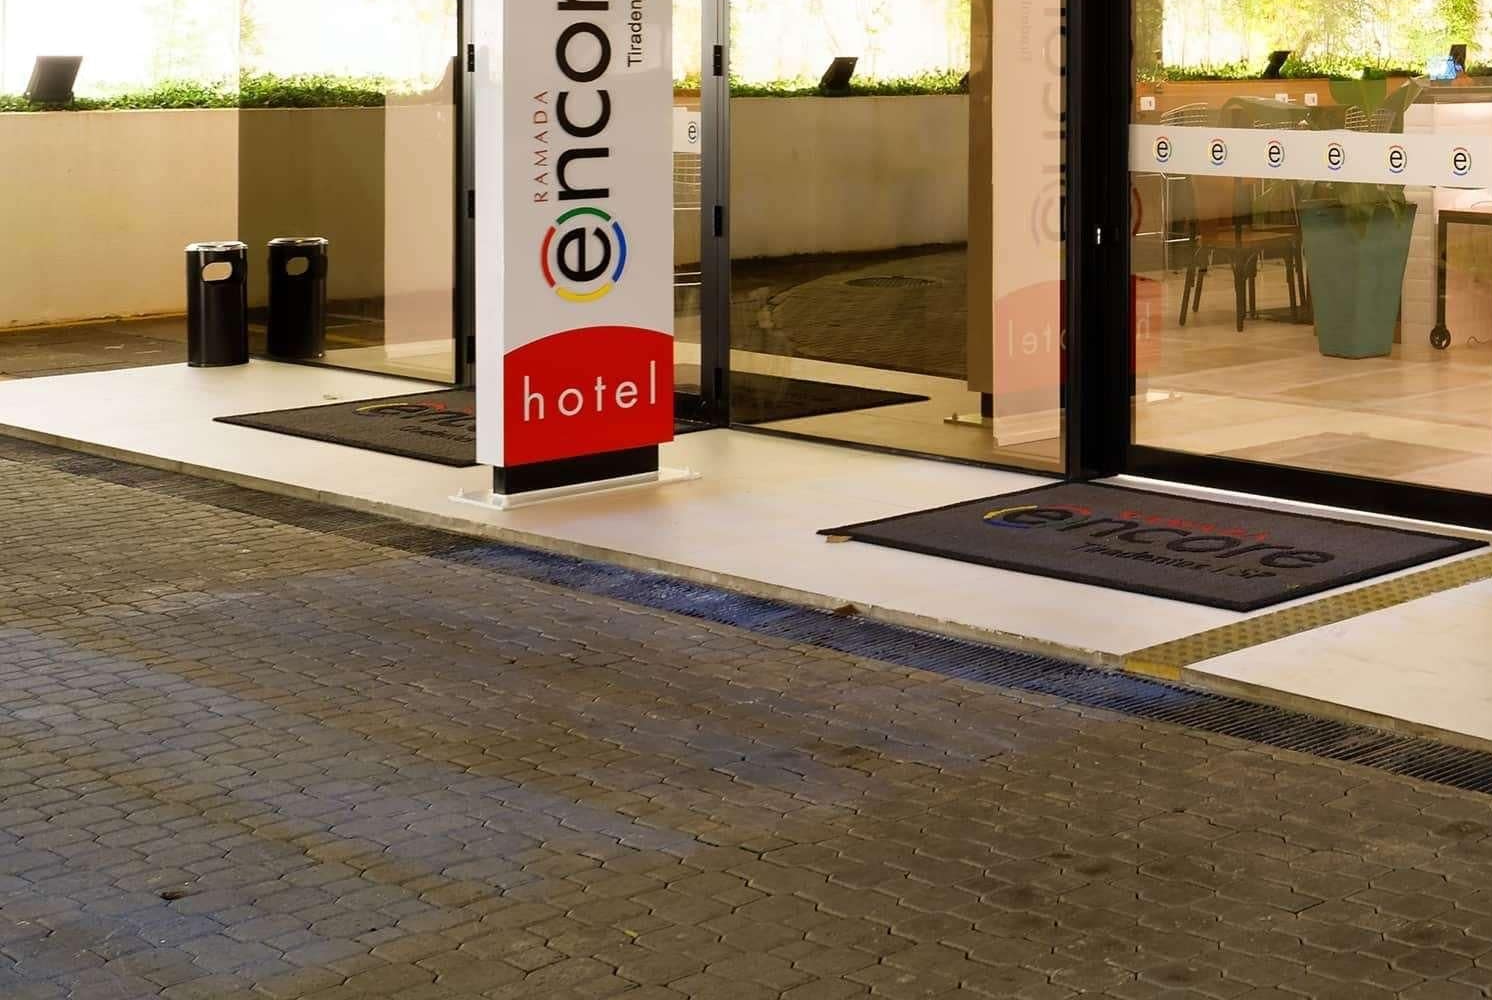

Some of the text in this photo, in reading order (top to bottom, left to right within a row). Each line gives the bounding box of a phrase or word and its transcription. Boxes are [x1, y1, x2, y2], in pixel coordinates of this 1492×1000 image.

[533, 90, 549, 204] RAMADA
[522, 360, 657, 422] hotel
[1001, 508, 1335, 569] encore
